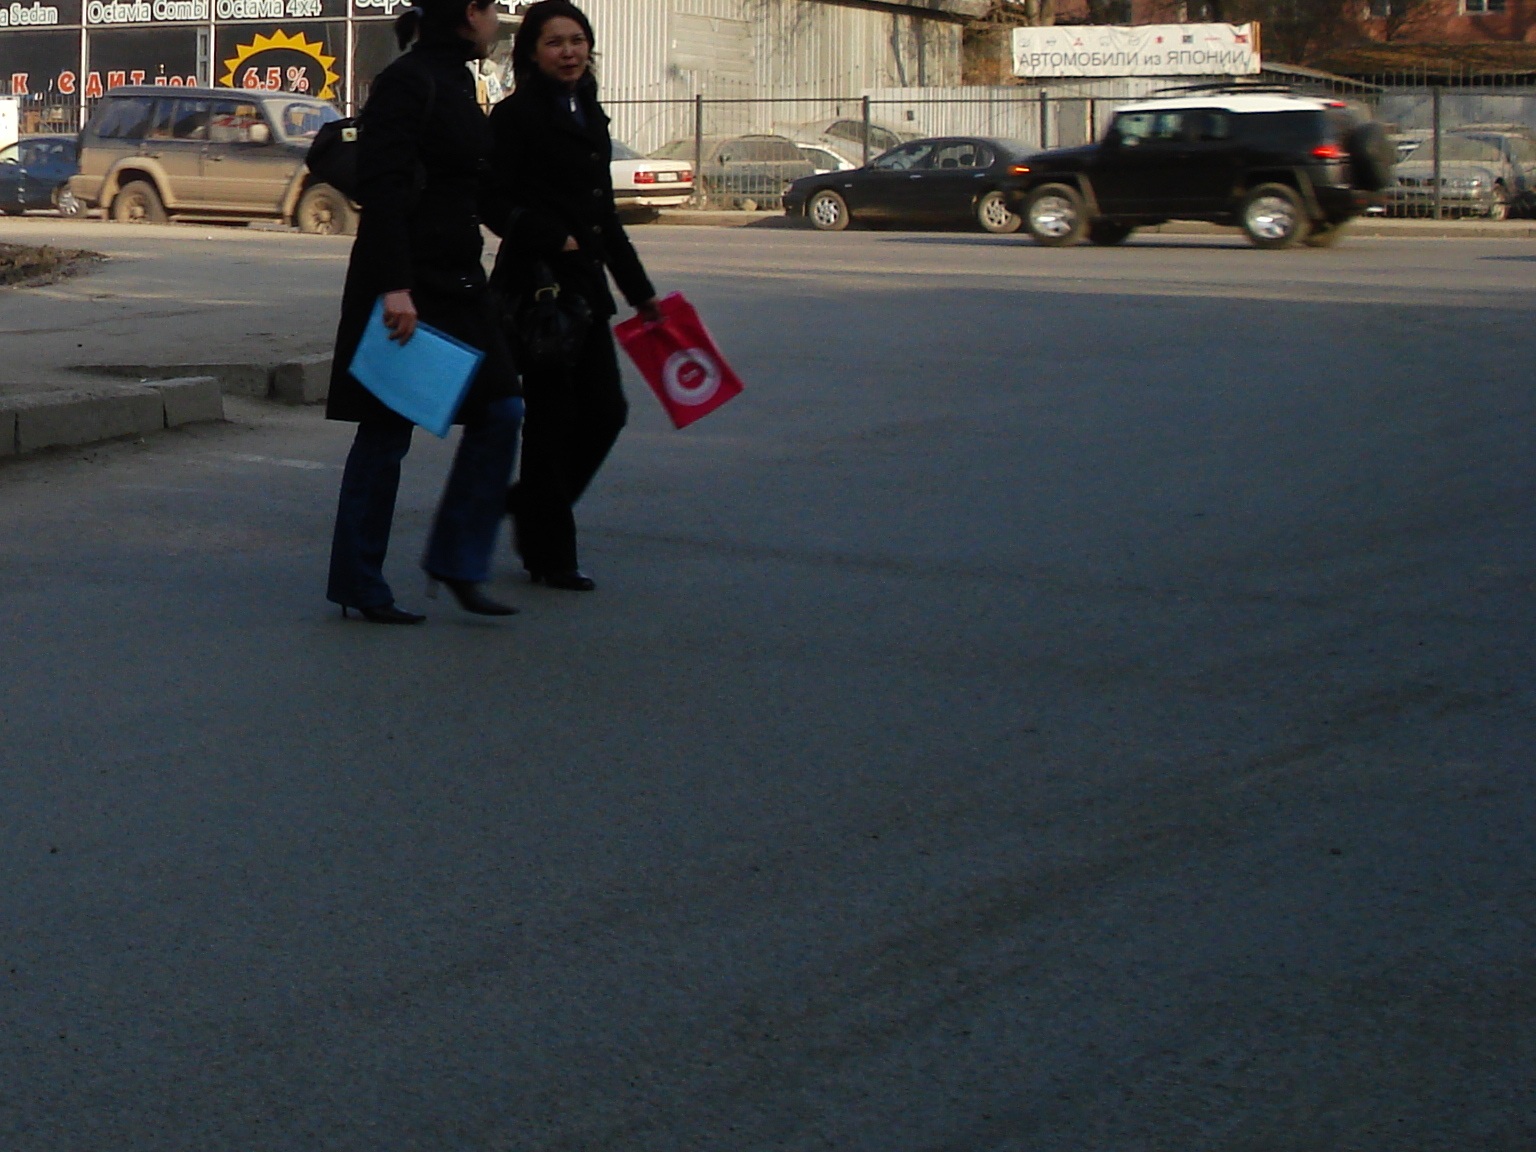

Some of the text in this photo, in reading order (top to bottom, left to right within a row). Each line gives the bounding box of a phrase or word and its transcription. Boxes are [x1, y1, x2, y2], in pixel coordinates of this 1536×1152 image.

[9, 1, 58, 25] Sedan
[88, 0, 152, 23] Octavia
[1019, 51, 1139, 67] АВТОМОБИЛИ
[1144, 55, 1161, 65] из
